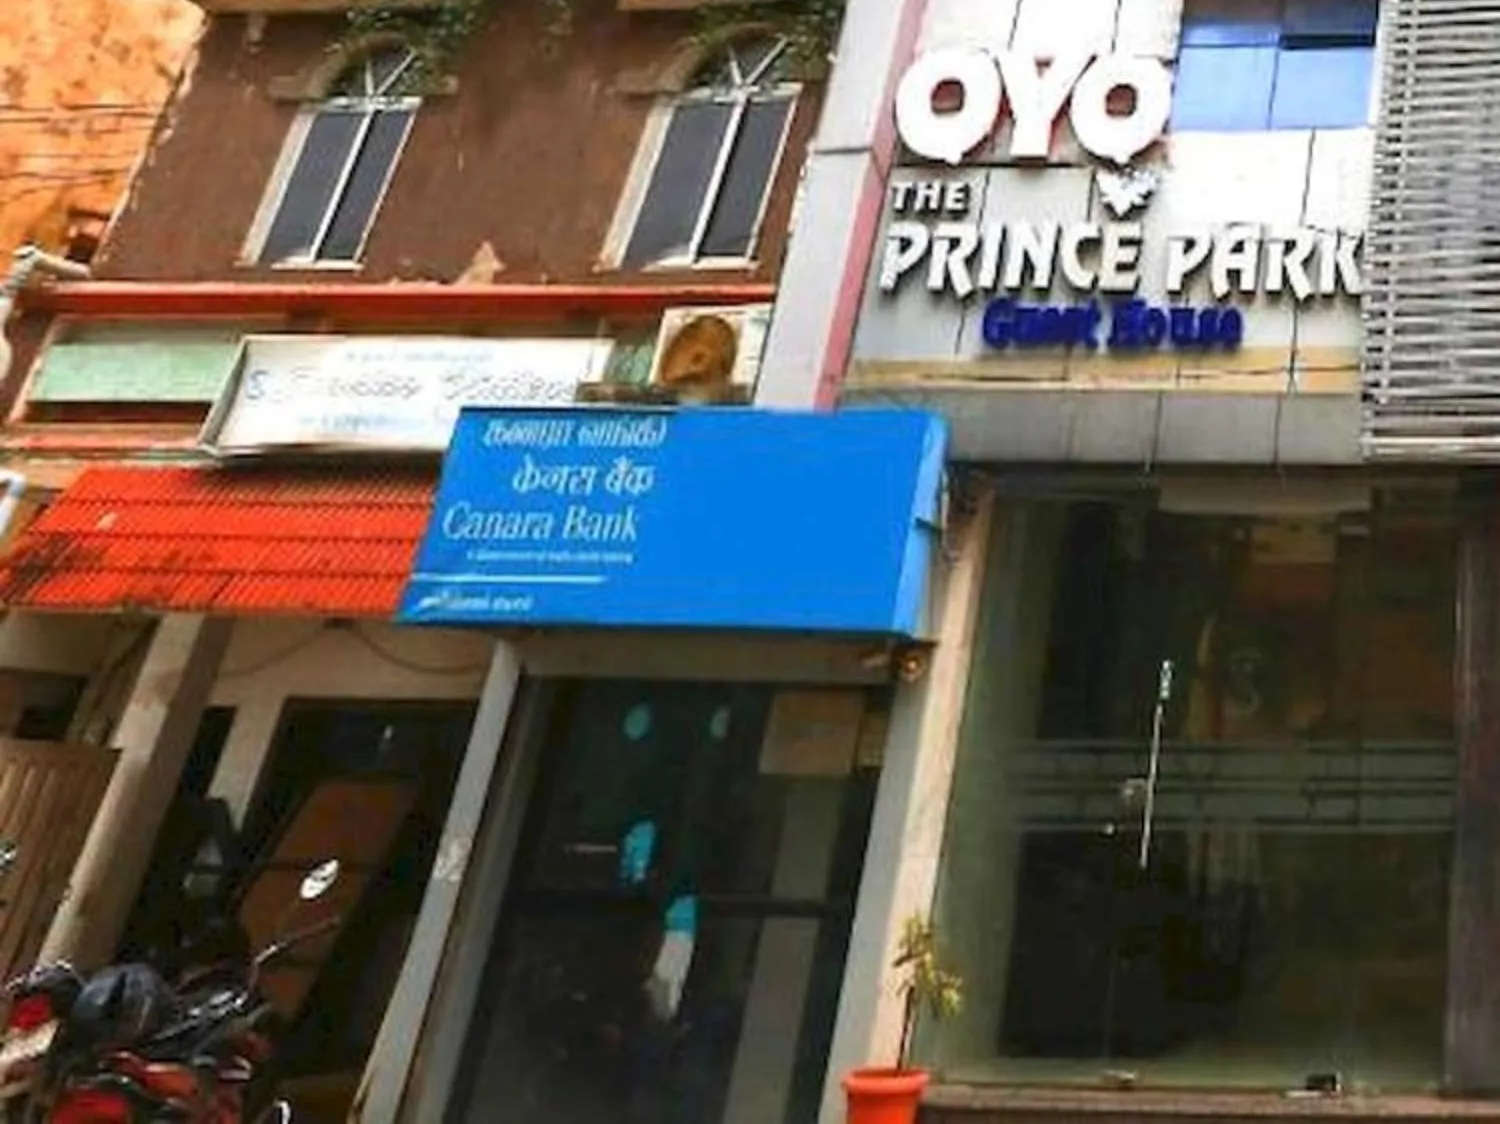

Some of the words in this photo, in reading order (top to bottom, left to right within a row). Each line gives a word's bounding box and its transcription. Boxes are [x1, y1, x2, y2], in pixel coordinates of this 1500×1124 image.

[895, 48, 1172, 167] OYO
[892, 180, 971, 213] THE
[878, 222, 1144, 298] PRINCE
[1166, 222, 1364, 300] PARK
[983, 297, 1100, 350] Guest
[1107, 298, 1243, 350] House
[443, 500, 554, 541] Canara
[562, 504, 638, 543] Bank
